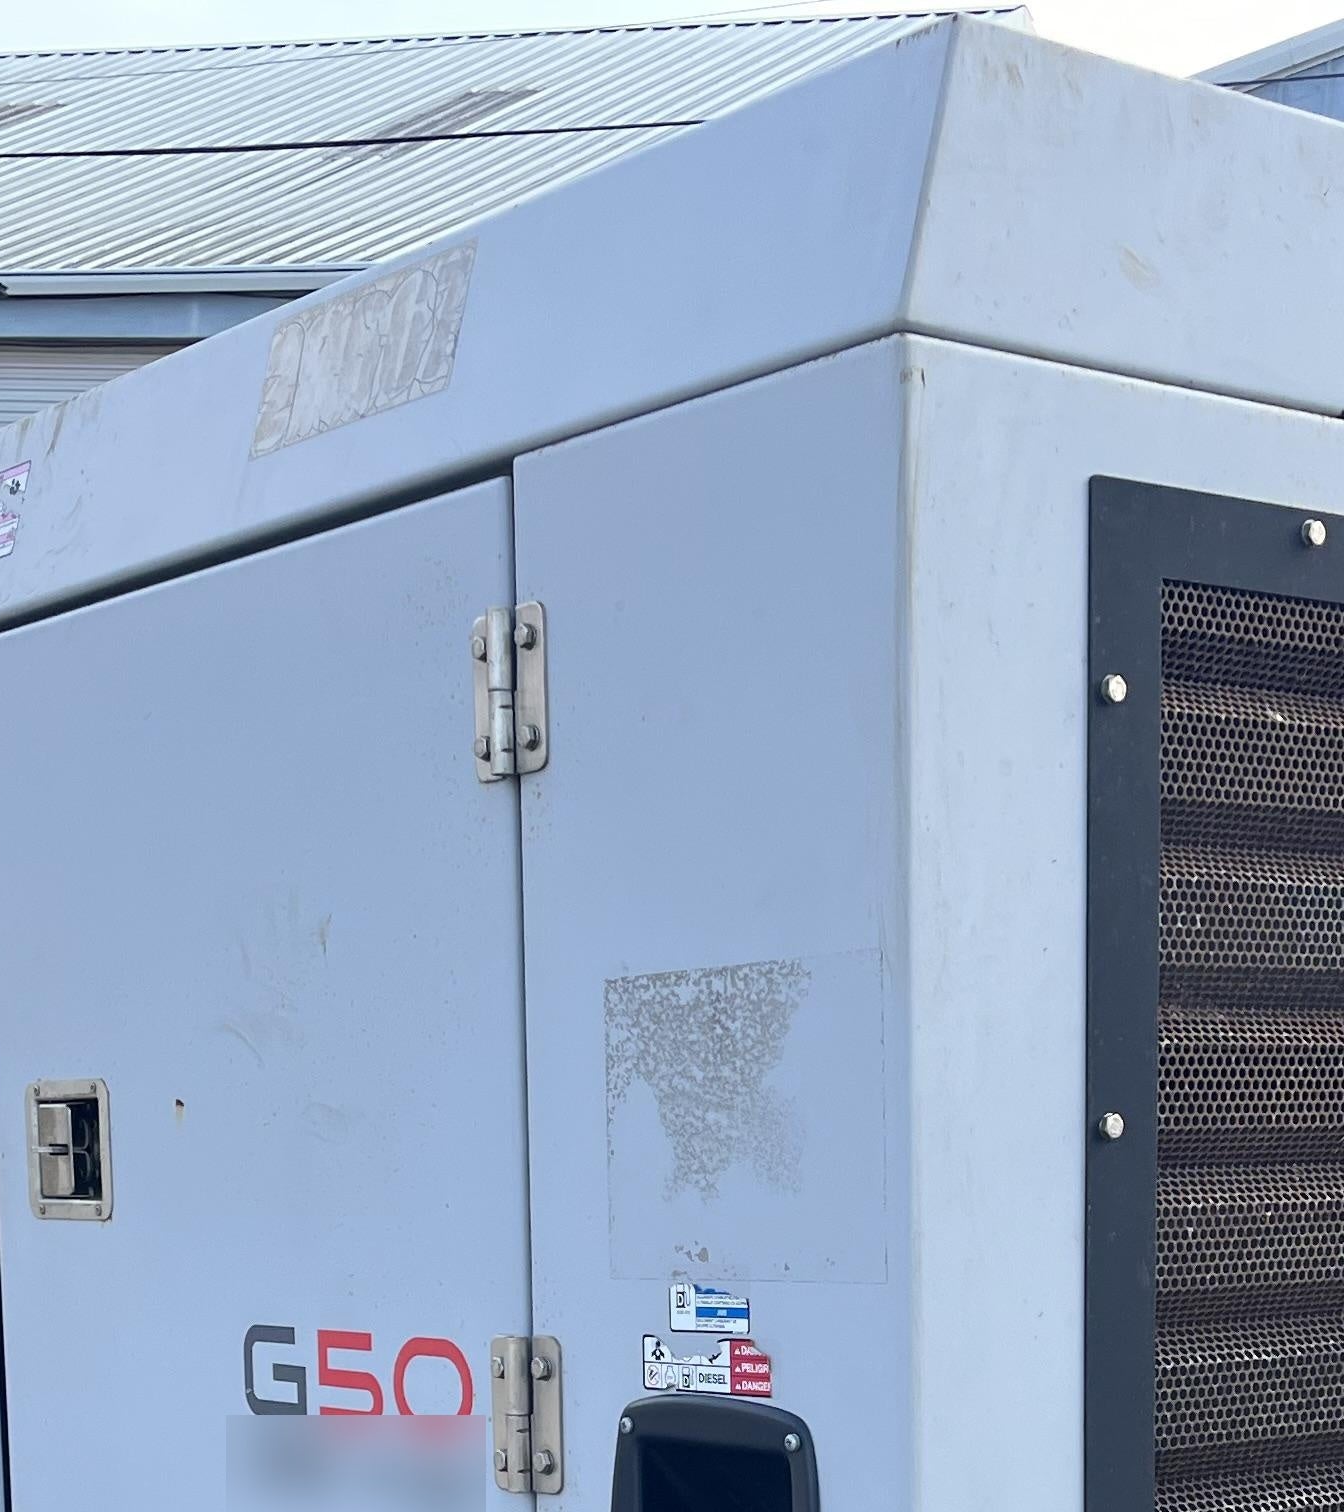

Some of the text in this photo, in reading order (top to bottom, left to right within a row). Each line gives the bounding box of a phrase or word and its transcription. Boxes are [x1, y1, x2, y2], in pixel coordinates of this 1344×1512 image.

[244, 1324, 473, 1416] G50
[698, 1373, 728, 1385] DIESEL
[741, 1380, 770, 1392] DANGE
